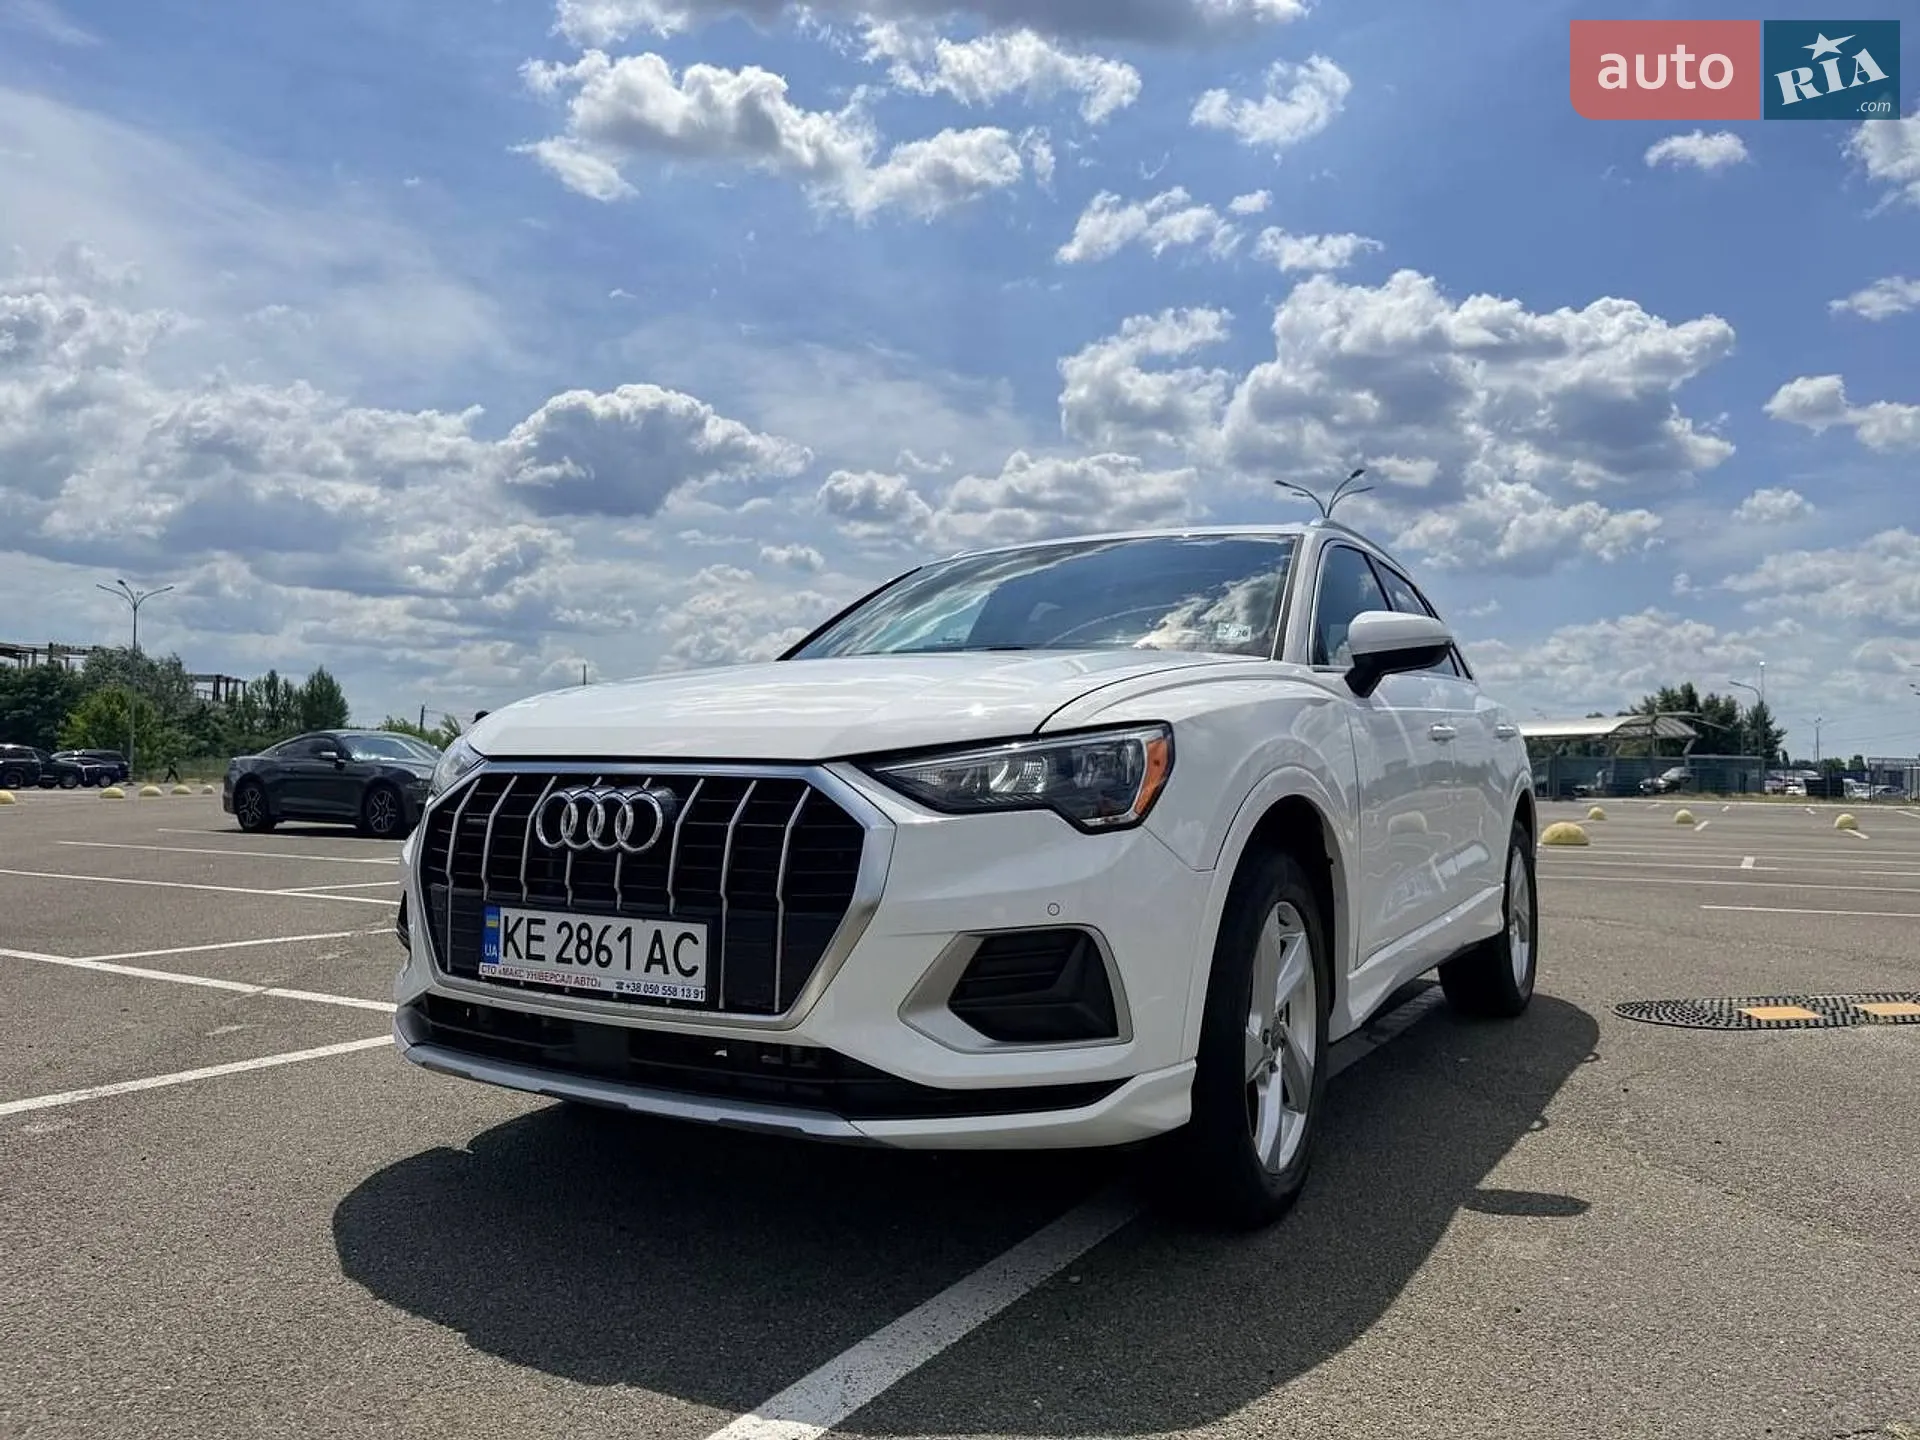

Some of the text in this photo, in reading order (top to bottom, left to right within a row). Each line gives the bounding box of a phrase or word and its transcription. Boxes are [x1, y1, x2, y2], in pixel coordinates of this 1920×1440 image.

[484, 943, 498, 958] UA
[503, 915, 699, 977] KE 2861 AC
[643, 984, 660, 995] 050
[681, 987, 692, 999] 13
[693, 988, 704, 1000] 91
